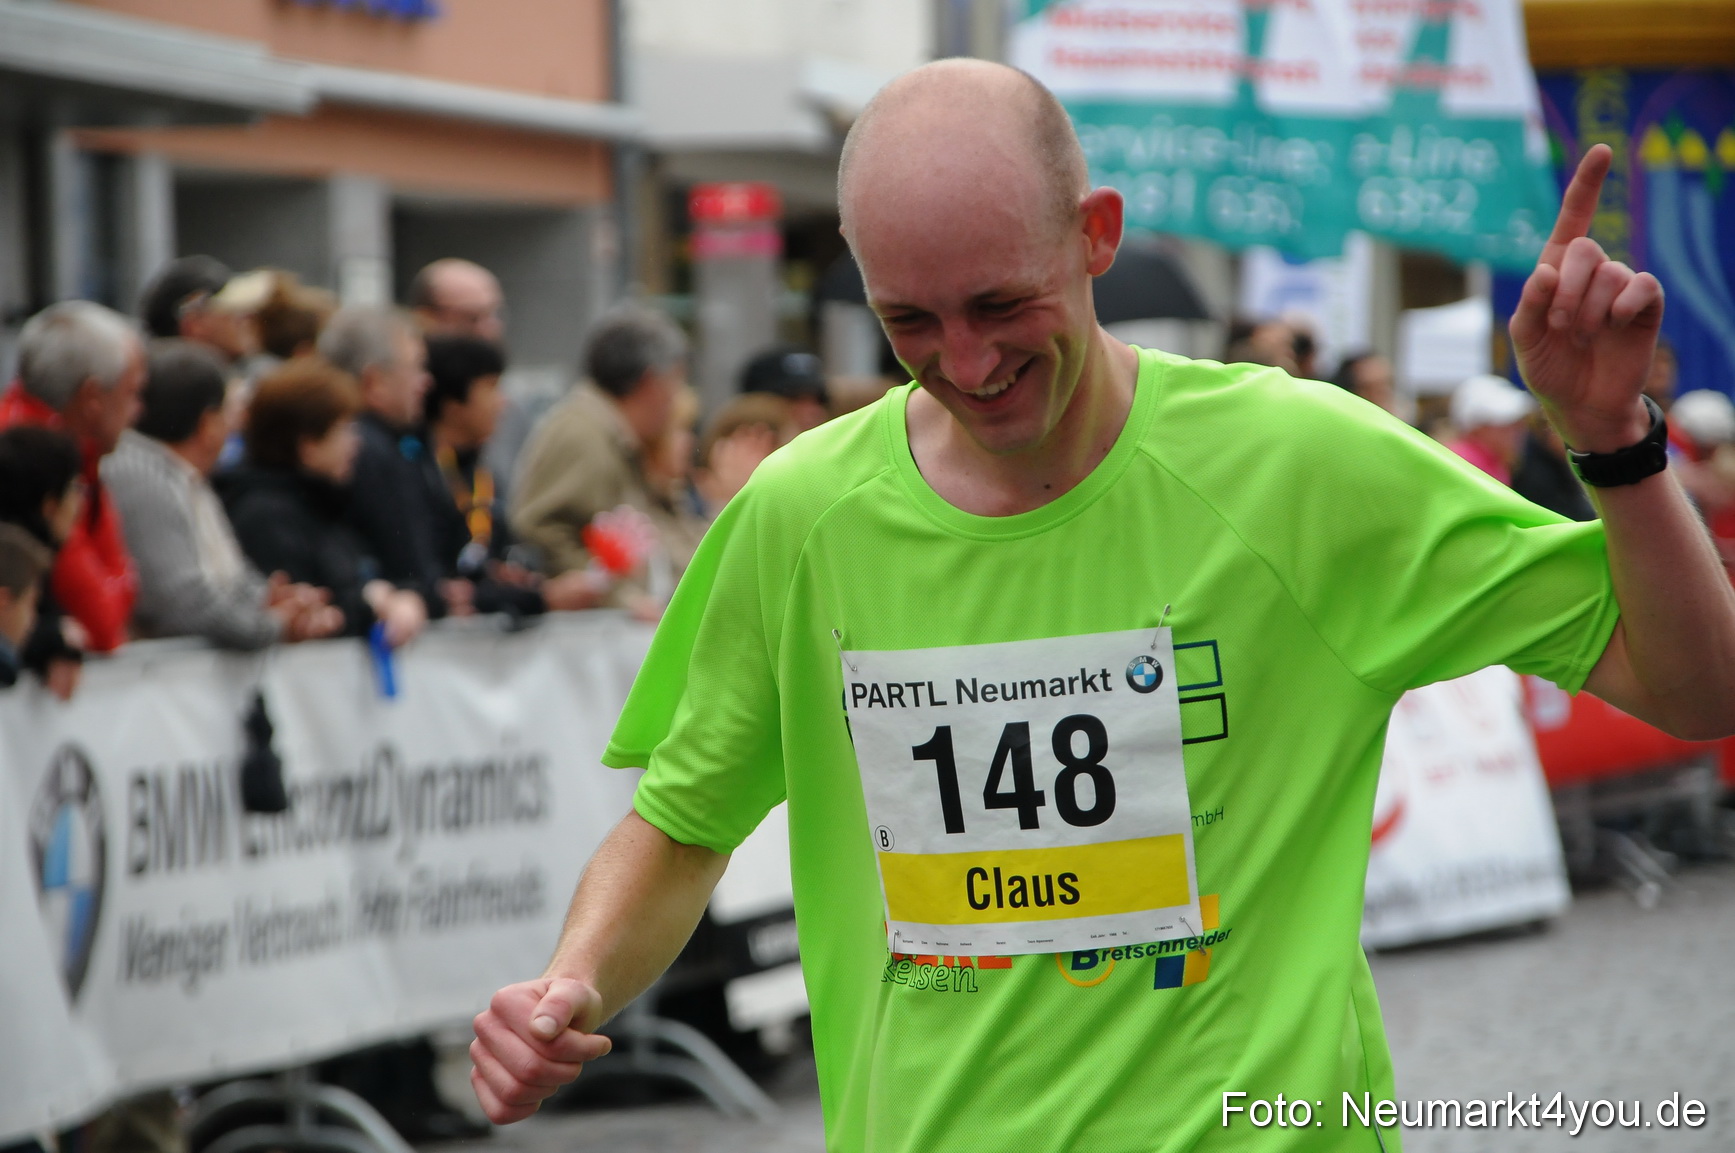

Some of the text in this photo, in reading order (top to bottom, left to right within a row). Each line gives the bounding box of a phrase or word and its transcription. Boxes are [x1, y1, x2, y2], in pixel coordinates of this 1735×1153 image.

[851, 668, 1112, 708] PARTL Neumarkt
[912, 714, 1116, 834] 148
[127, 762, 230, 878] BMW
[1191, 806, 1224, 826] mbH
[966, 867, 1080, 910] Claus
